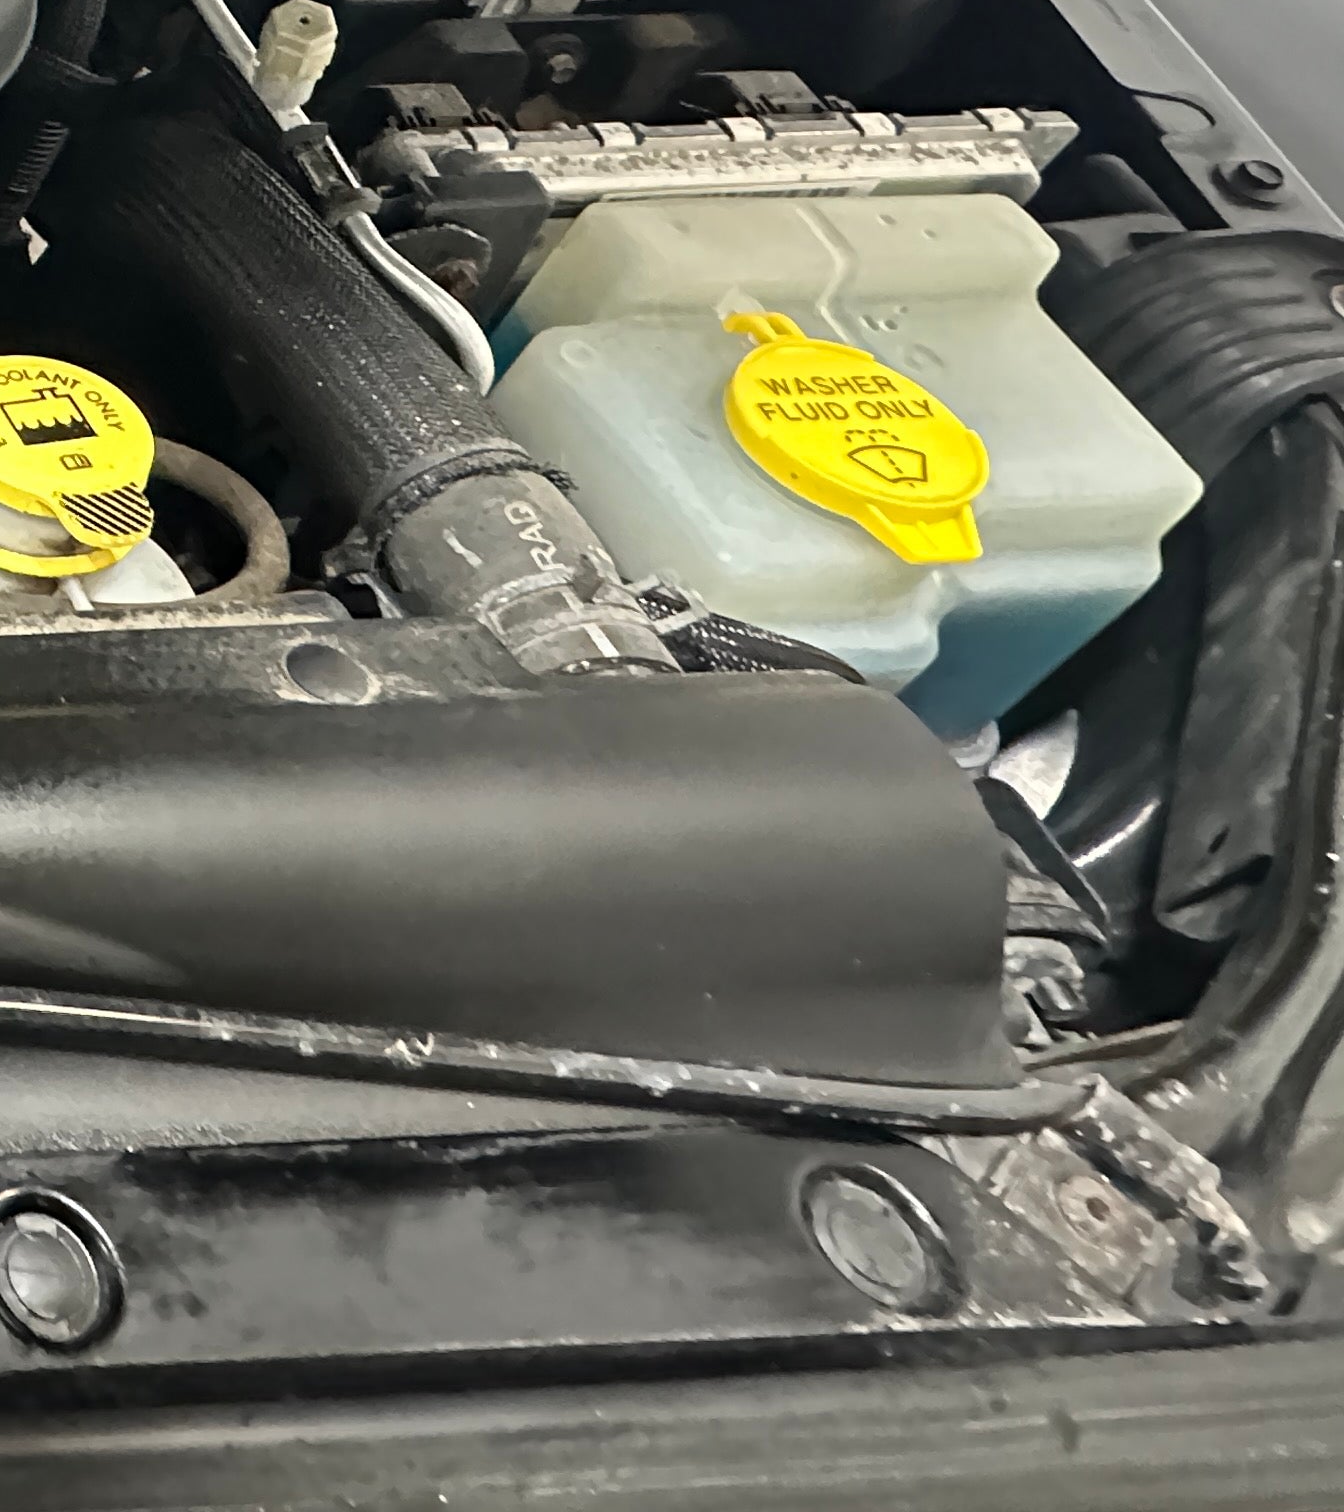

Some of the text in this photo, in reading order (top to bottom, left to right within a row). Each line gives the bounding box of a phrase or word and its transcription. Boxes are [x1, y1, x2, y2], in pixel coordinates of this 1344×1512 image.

[758, 375, 900, 396] WASHER
[85, 390, 126, 432] ONLY
[757, 399, 937, 421] FLUID ONLY
